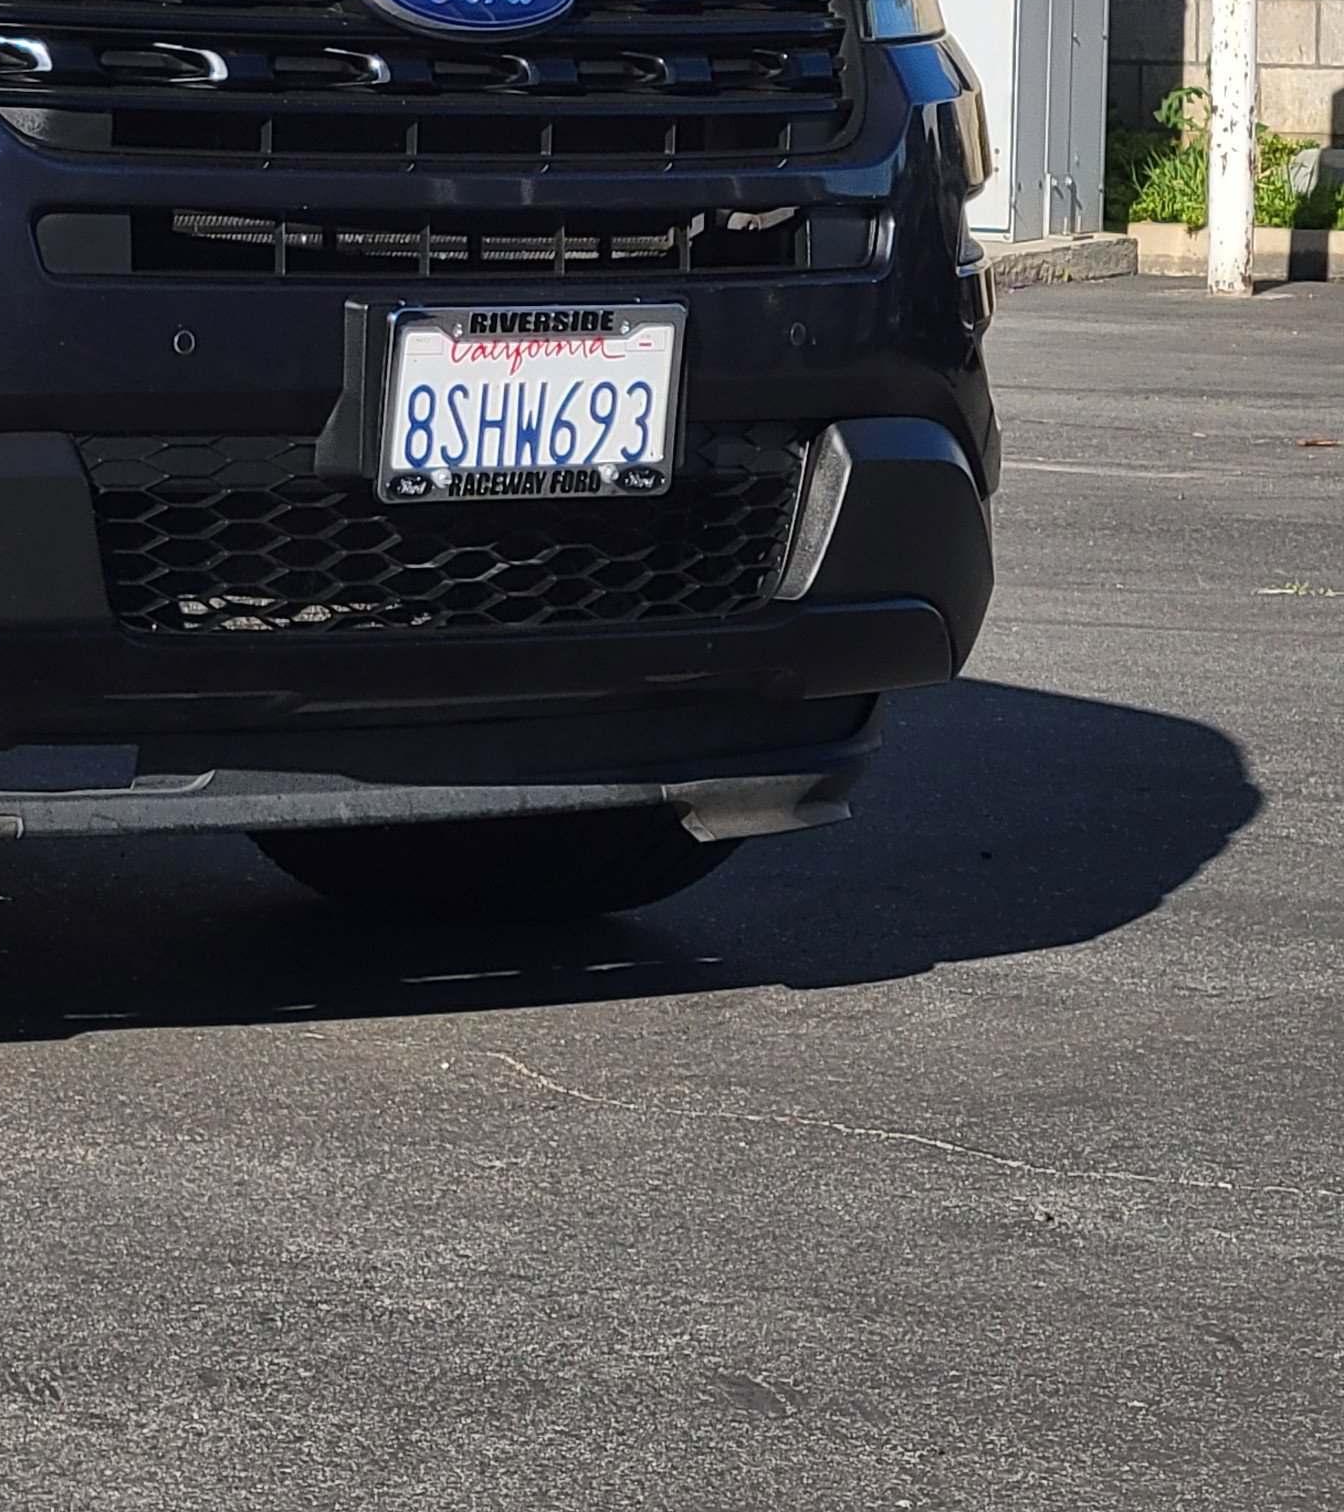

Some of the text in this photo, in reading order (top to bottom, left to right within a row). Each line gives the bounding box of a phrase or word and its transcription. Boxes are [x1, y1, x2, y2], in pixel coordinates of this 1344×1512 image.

[470, 311, 614, 334] RIVERSIDE
[450, 335, 625, 376] California
[404, 380, 653, 472] 8SHW693
[448, 469, 602, 497] RACEWAY FORD
